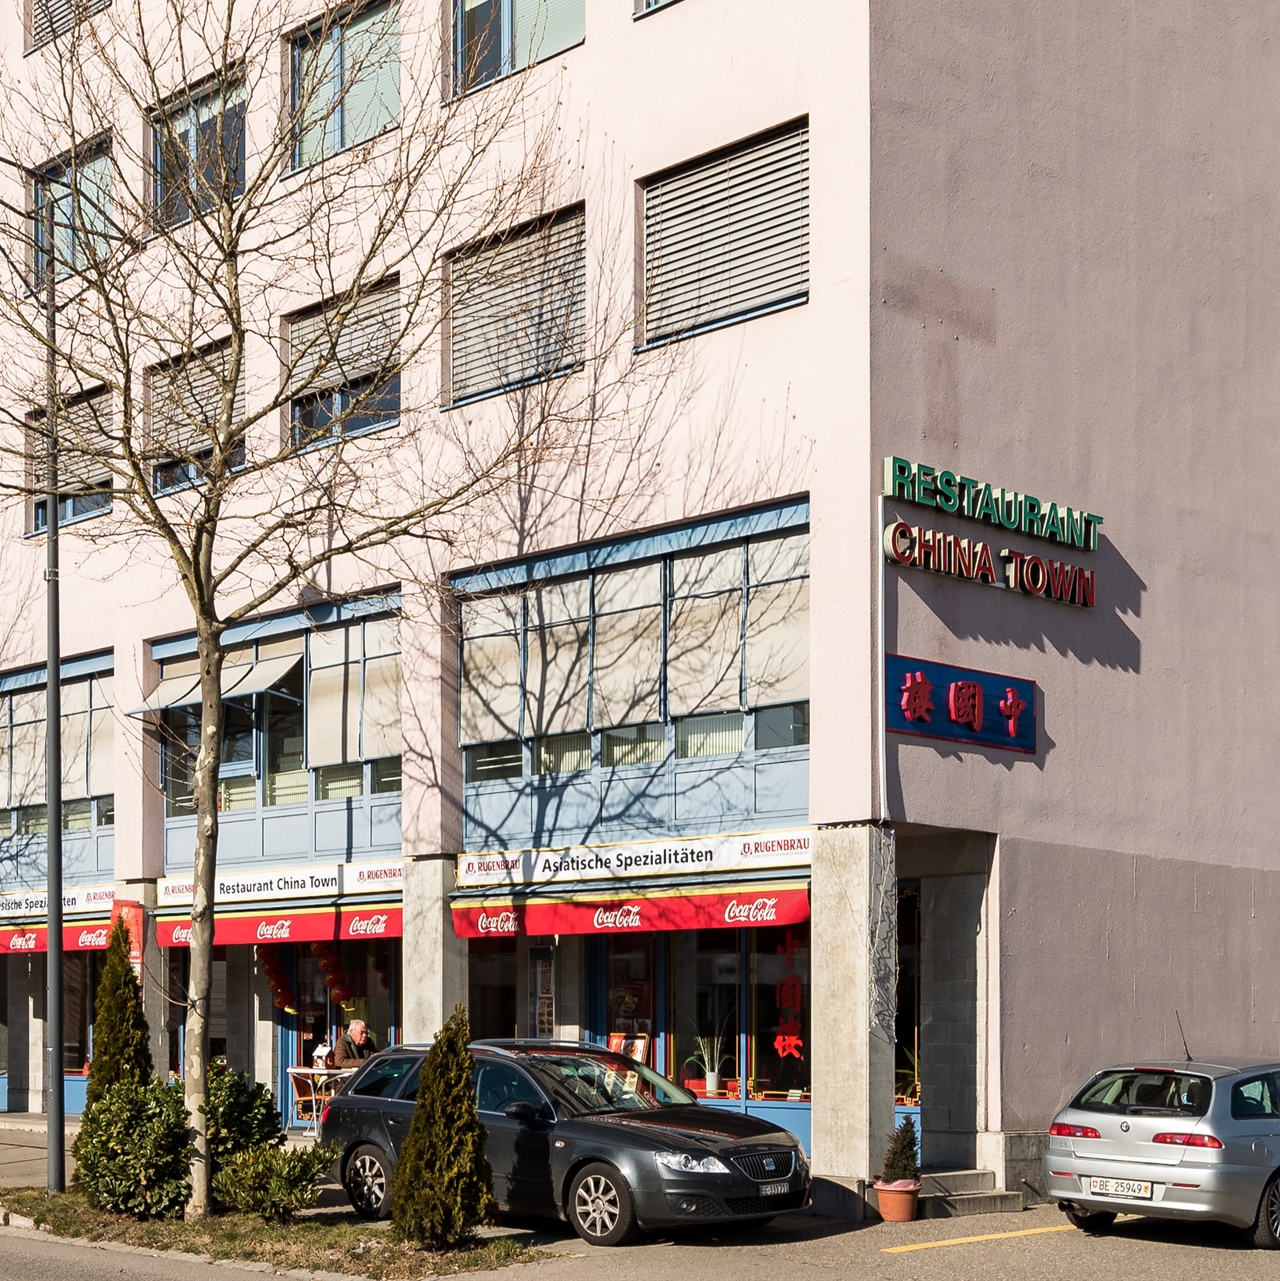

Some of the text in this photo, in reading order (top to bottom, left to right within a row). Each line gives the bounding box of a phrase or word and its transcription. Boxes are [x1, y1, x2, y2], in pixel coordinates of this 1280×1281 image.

[884, 455, 1104, 551] RESTAURANT
[884, 520, 1097, 607] CHINA TOWN
[754, 837, 810, 852] RUGENBRÄU
[477, 859, 521, 872] RUGENBRÄU
[542, 847, 714, 873] Asiatische Spezialitäten
[367, 868, 403, 881] RUGENBRÄ
[219, 875, 337, 895] Restaurant China Town
[24, 895, 77, 913] Speziten
[93, 890, 116, 901] RUGENBR
[593, 905, 641, 929] Coca-Cola
[724, 897, 778, 923] Coca-Cola
